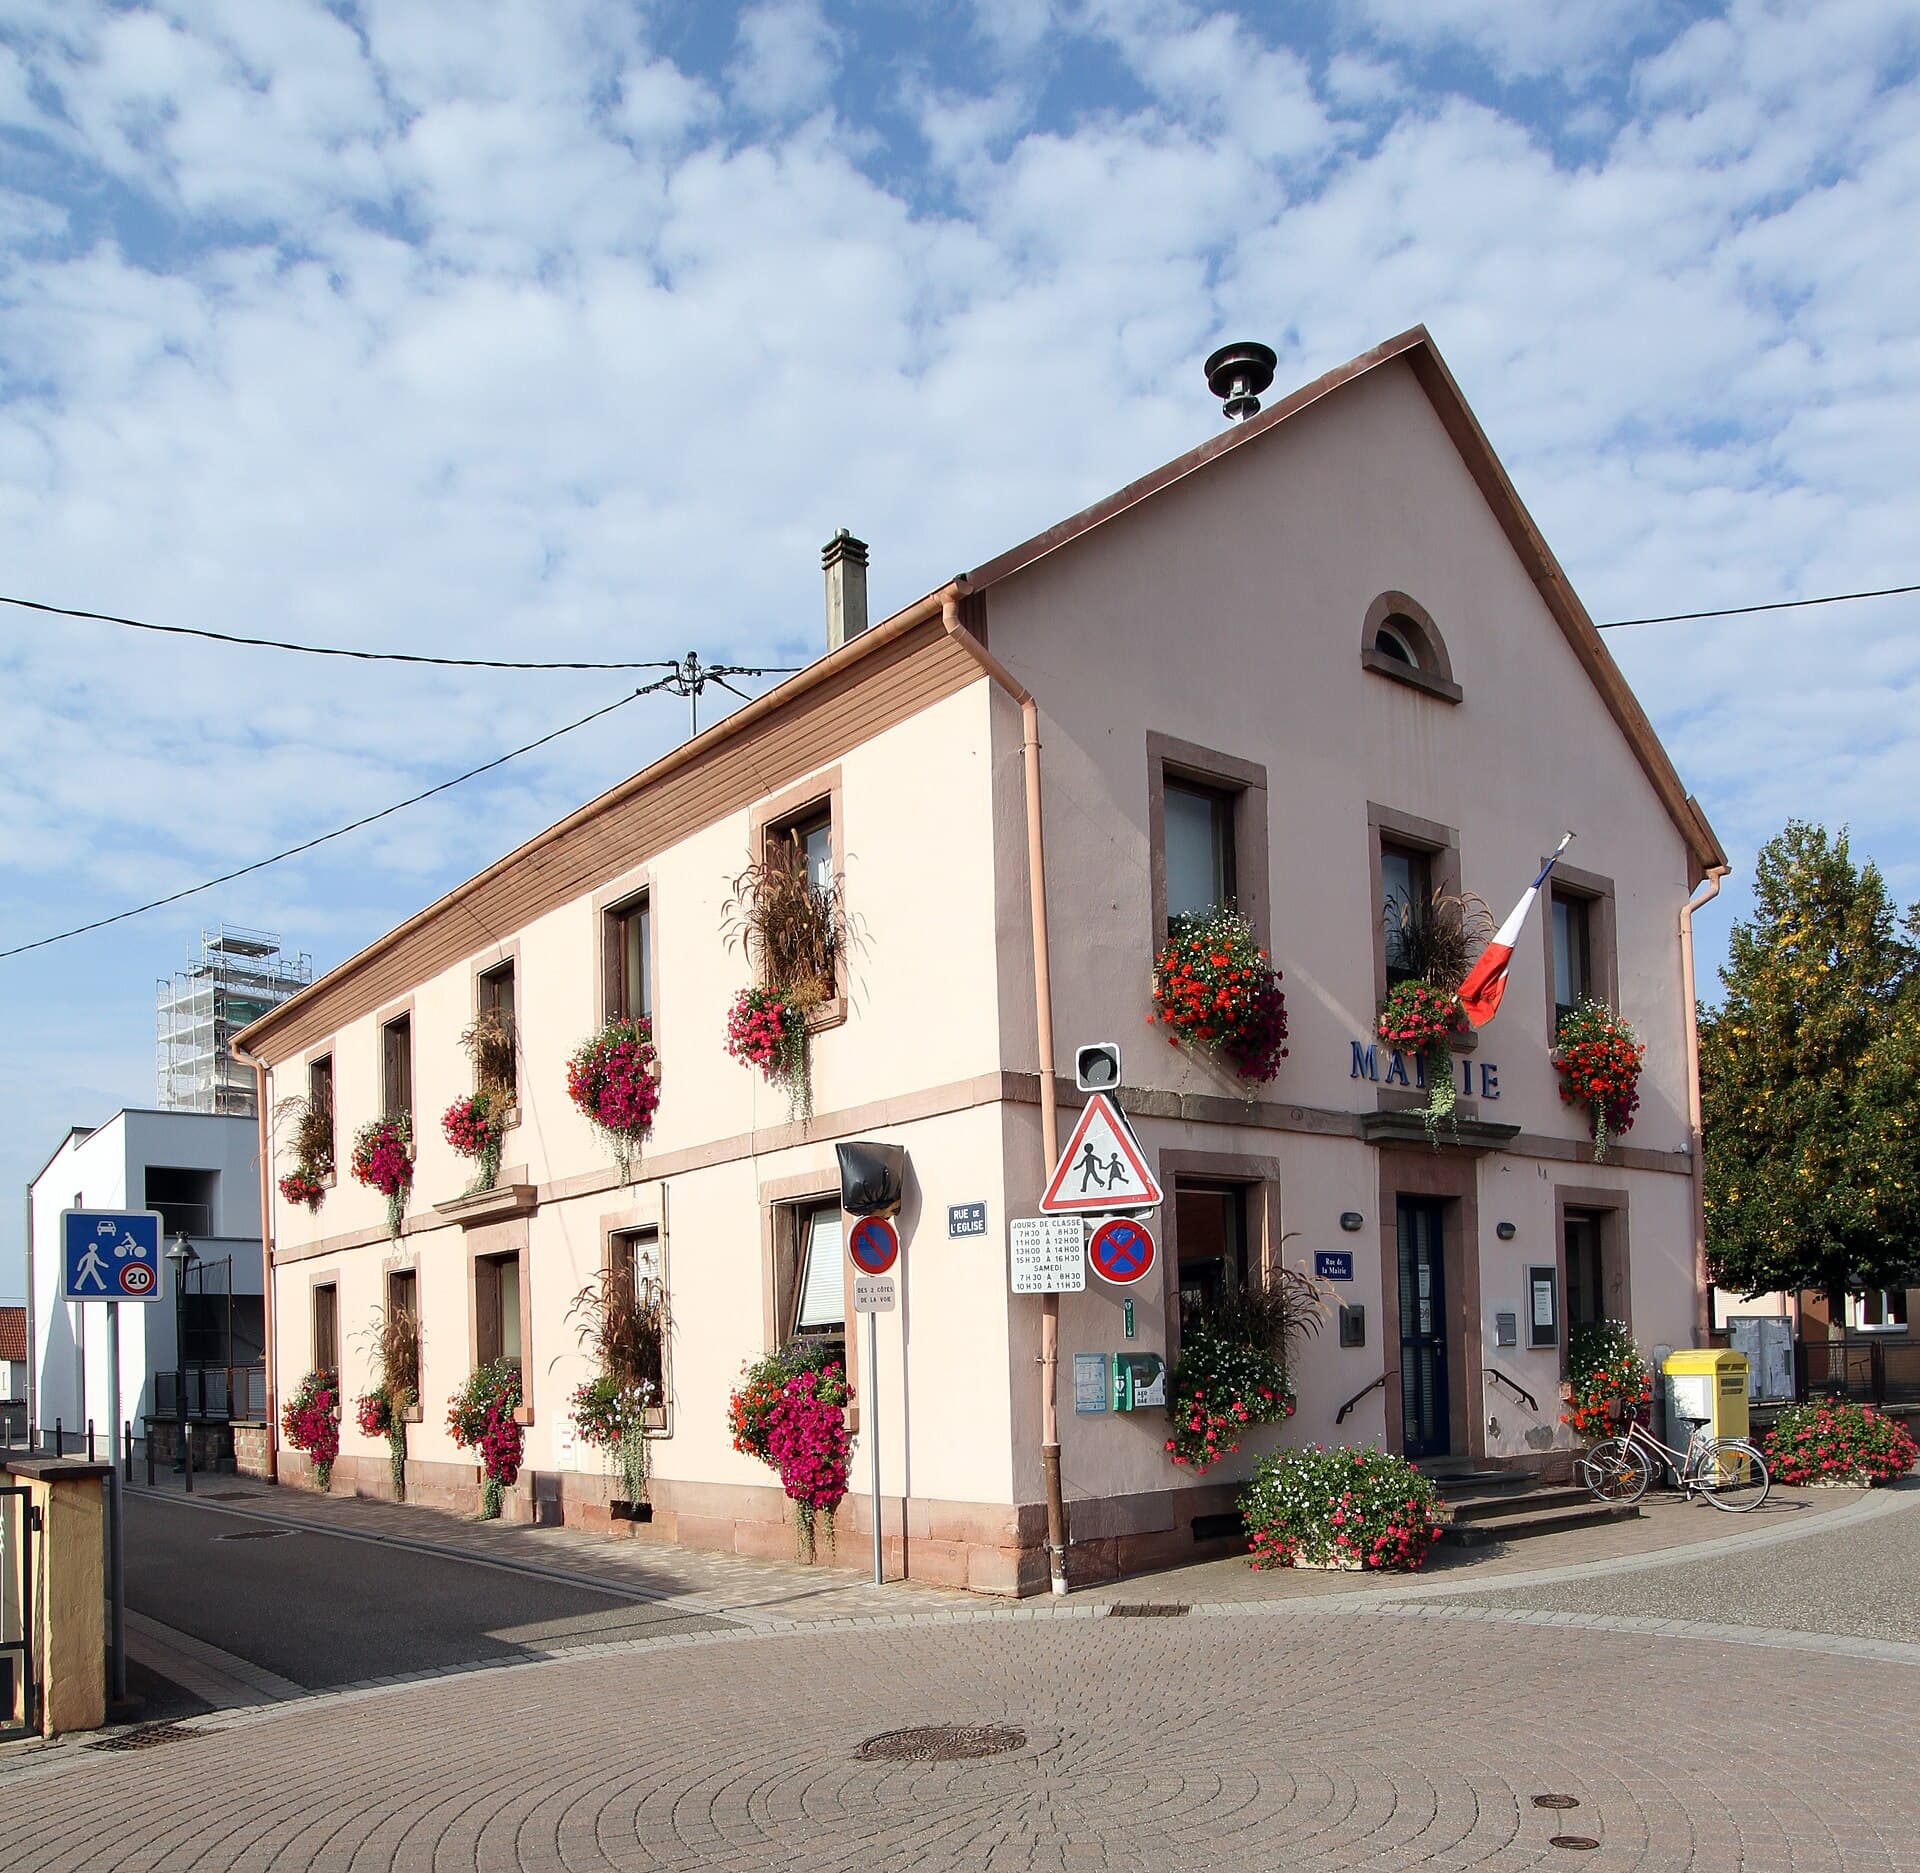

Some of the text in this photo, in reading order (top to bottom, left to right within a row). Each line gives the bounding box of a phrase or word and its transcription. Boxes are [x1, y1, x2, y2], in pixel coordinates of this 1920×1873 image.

[1350, 1041, 1500, 1099] MAIIE
[953, 1208, 980, 1220] RUE DE
[1013, 1219, 1081, 1229] JOURS DE CLASSE
[1325, 1257, 1343, 1266] Rue de
[1034, 1264, 1062, 1272] SAMEDI
[1321, 1266, 1347, 1274] la Mairie
[128, 1272, 148, 1285] 20
